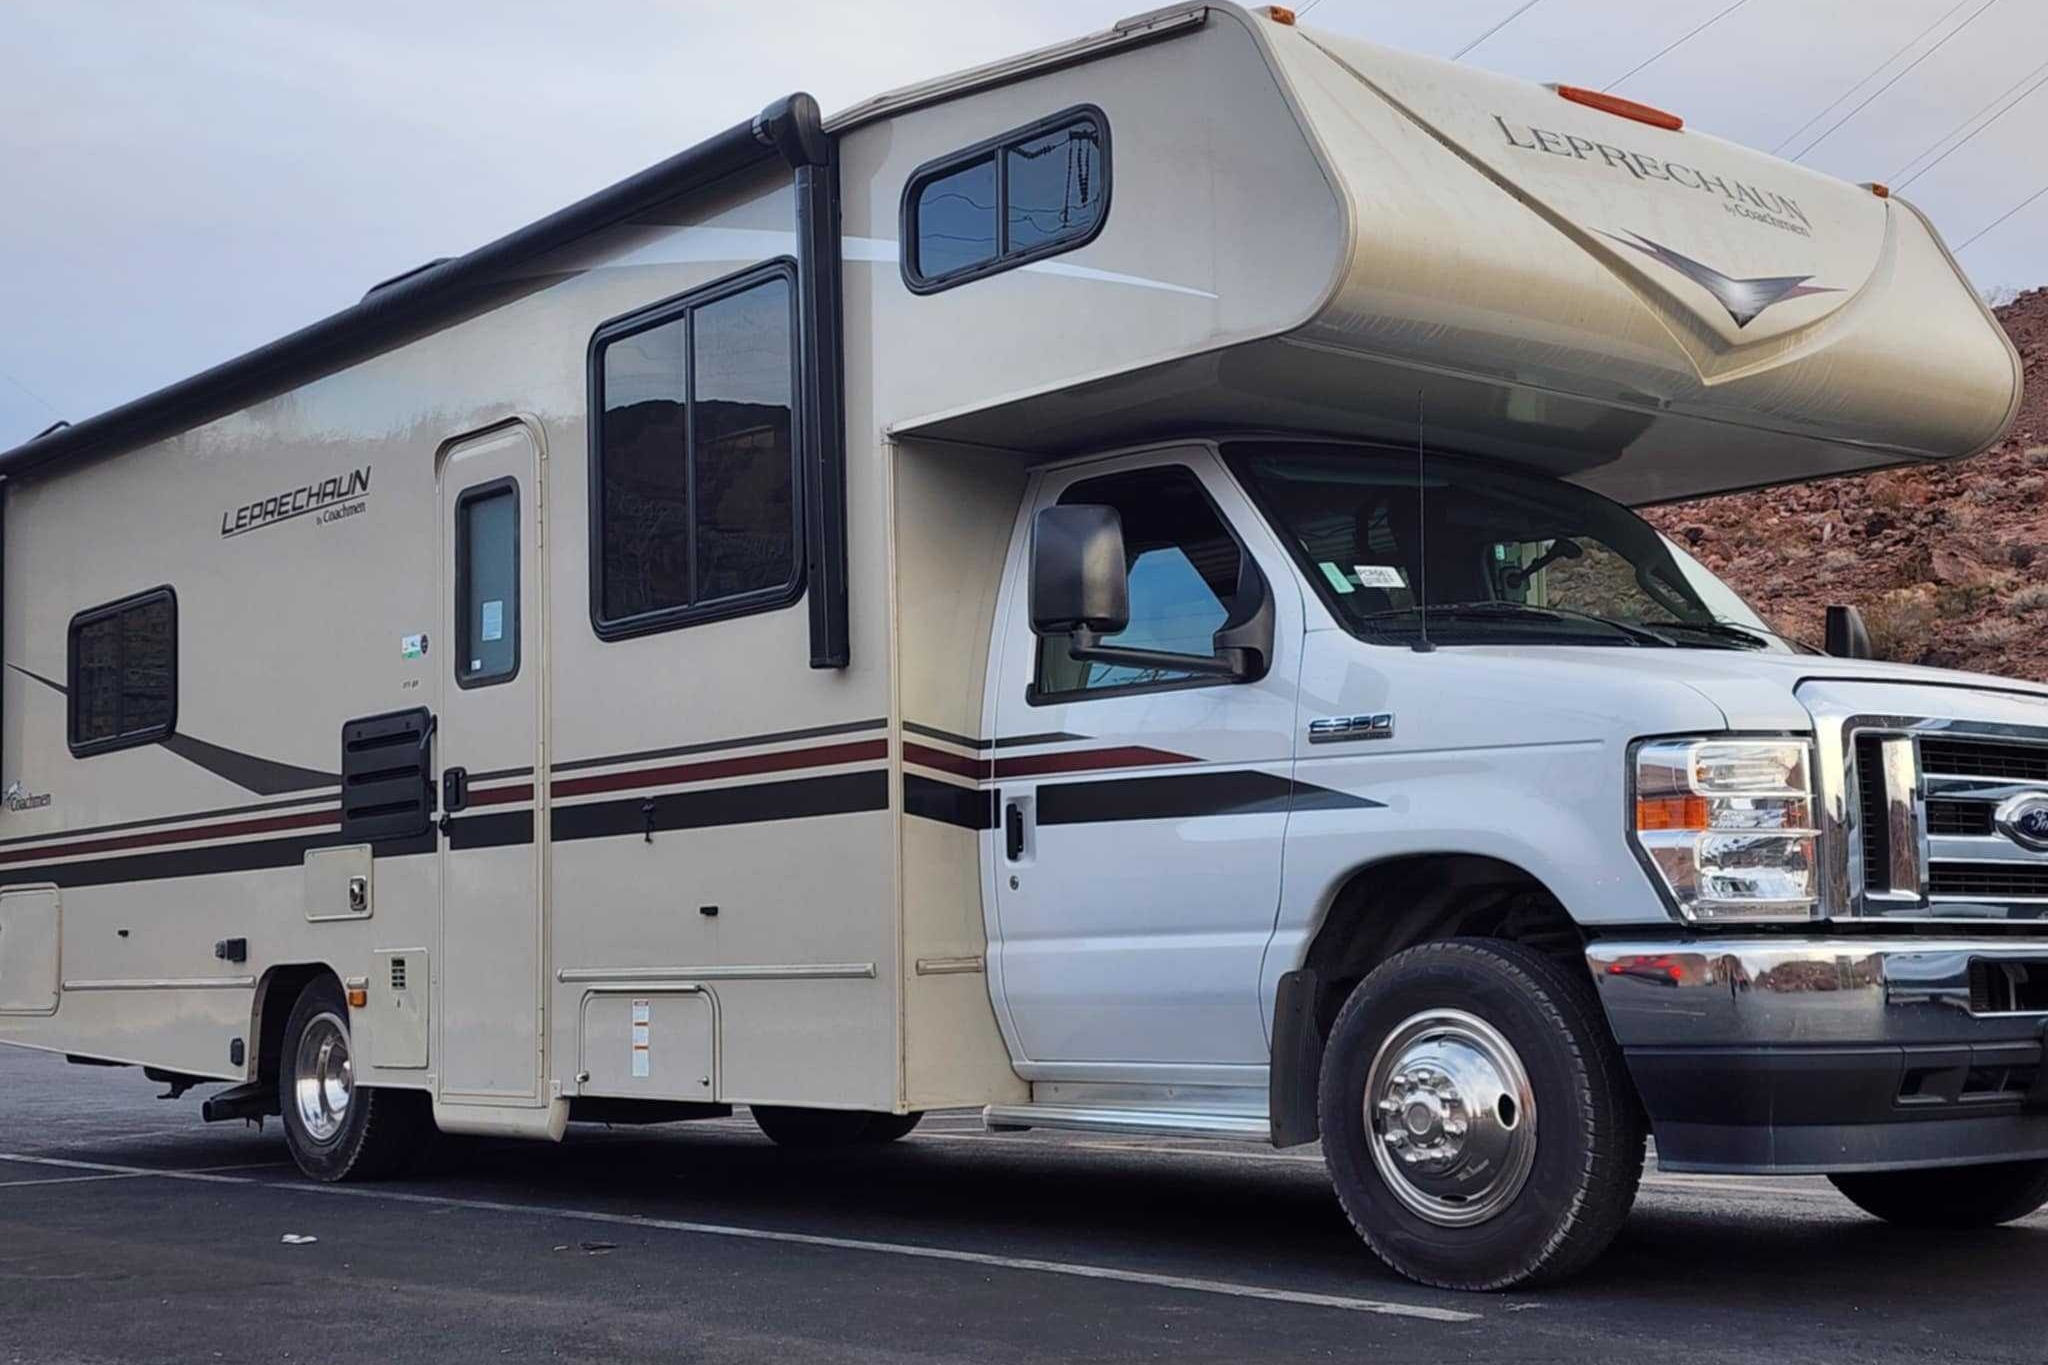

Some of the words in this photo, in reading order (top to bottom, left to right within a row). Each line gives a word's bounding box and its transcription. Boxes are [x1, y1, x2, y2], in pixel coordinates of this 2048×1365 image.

[1491, 113, 1812, 231] LEPRECHAUN
[1735, 204, 1811, 238] Coachmen
[221, 465, 372, 535] LEPRECHAUN
[323, 501, 367, 523] Coachmen
[10, 793, 51, 812] Coachmen
